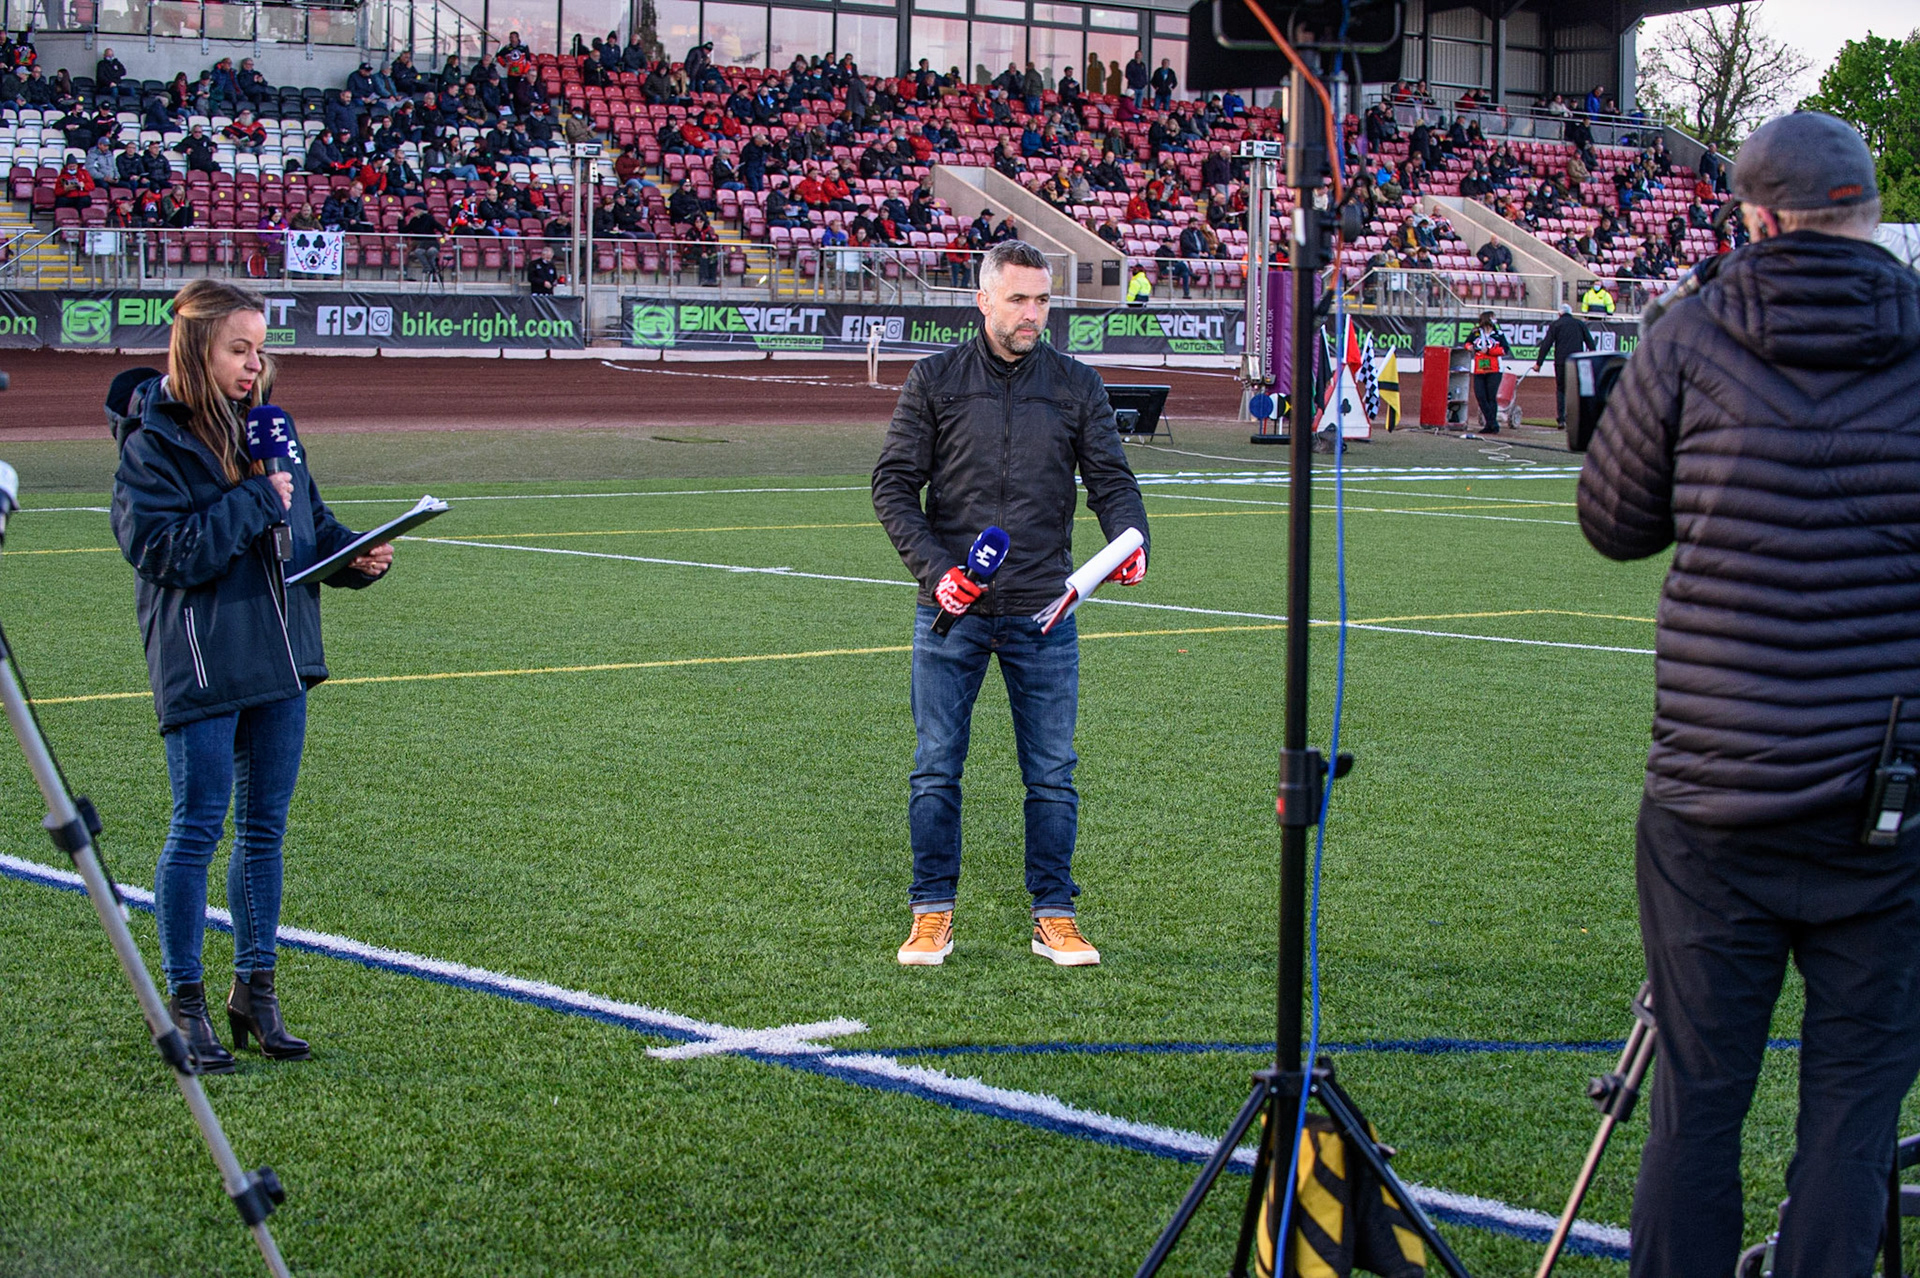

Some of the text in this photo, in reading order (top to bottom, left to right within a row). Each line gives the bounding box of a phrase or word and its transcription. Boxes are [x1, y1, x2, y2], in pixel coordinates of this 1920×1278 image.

[402, 311, 574, 342] bike-right.com
[680, 305, 826, 333] BIKERIGHT
[1107, 315, 1224, 337] BIKERIGHT
